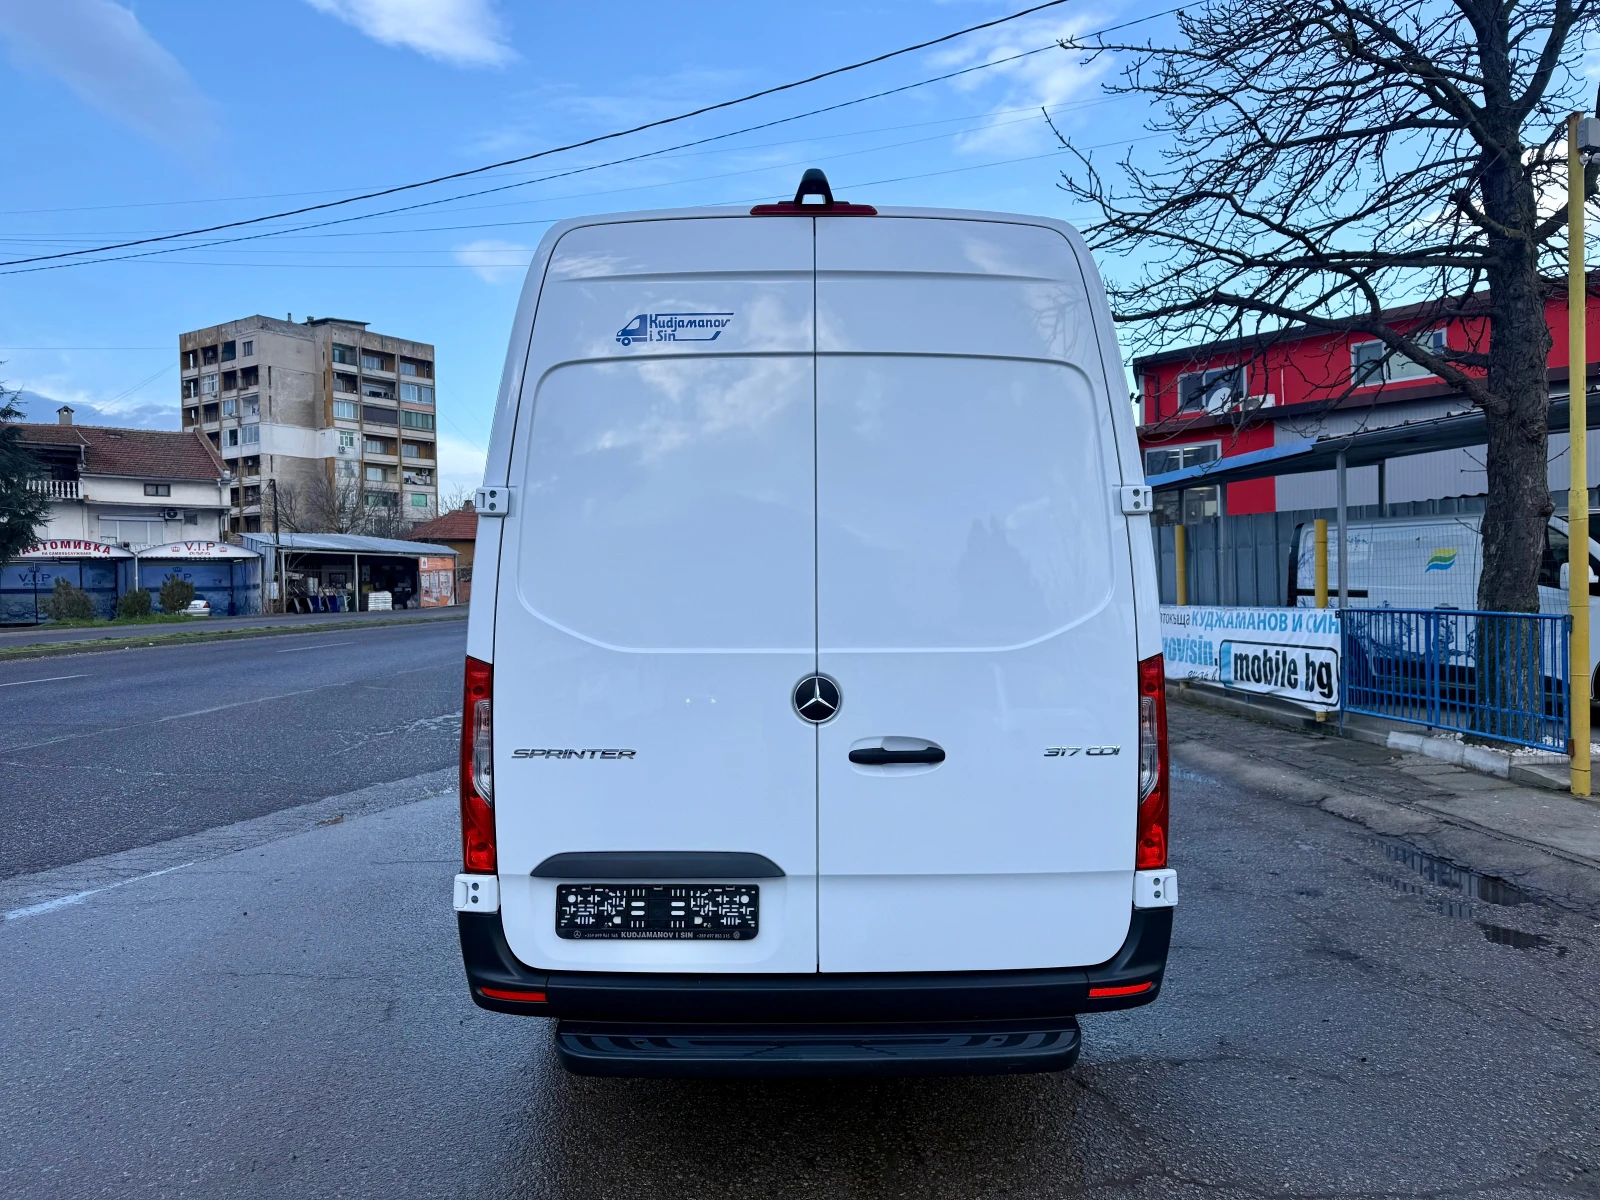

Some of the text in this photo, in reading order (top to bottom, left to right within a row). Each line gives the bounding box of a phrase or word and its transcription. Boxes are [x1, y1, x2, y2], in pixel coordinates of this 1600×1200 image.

[649, 313, 731, 332] Kudjamanov
[656, 330, 676, 342] Sin
[1191, 610, 1288, 632] КУДЖАМАНОВ
[1291, 613, 1303, 632] И
[1305, 614, 1340, 634] СИН
[1233, 648, 1334, 699] mobile.bg
[511, 748, 637, 760] SPRINTER
[1043, 745, 1121, 757] 317 CDI
